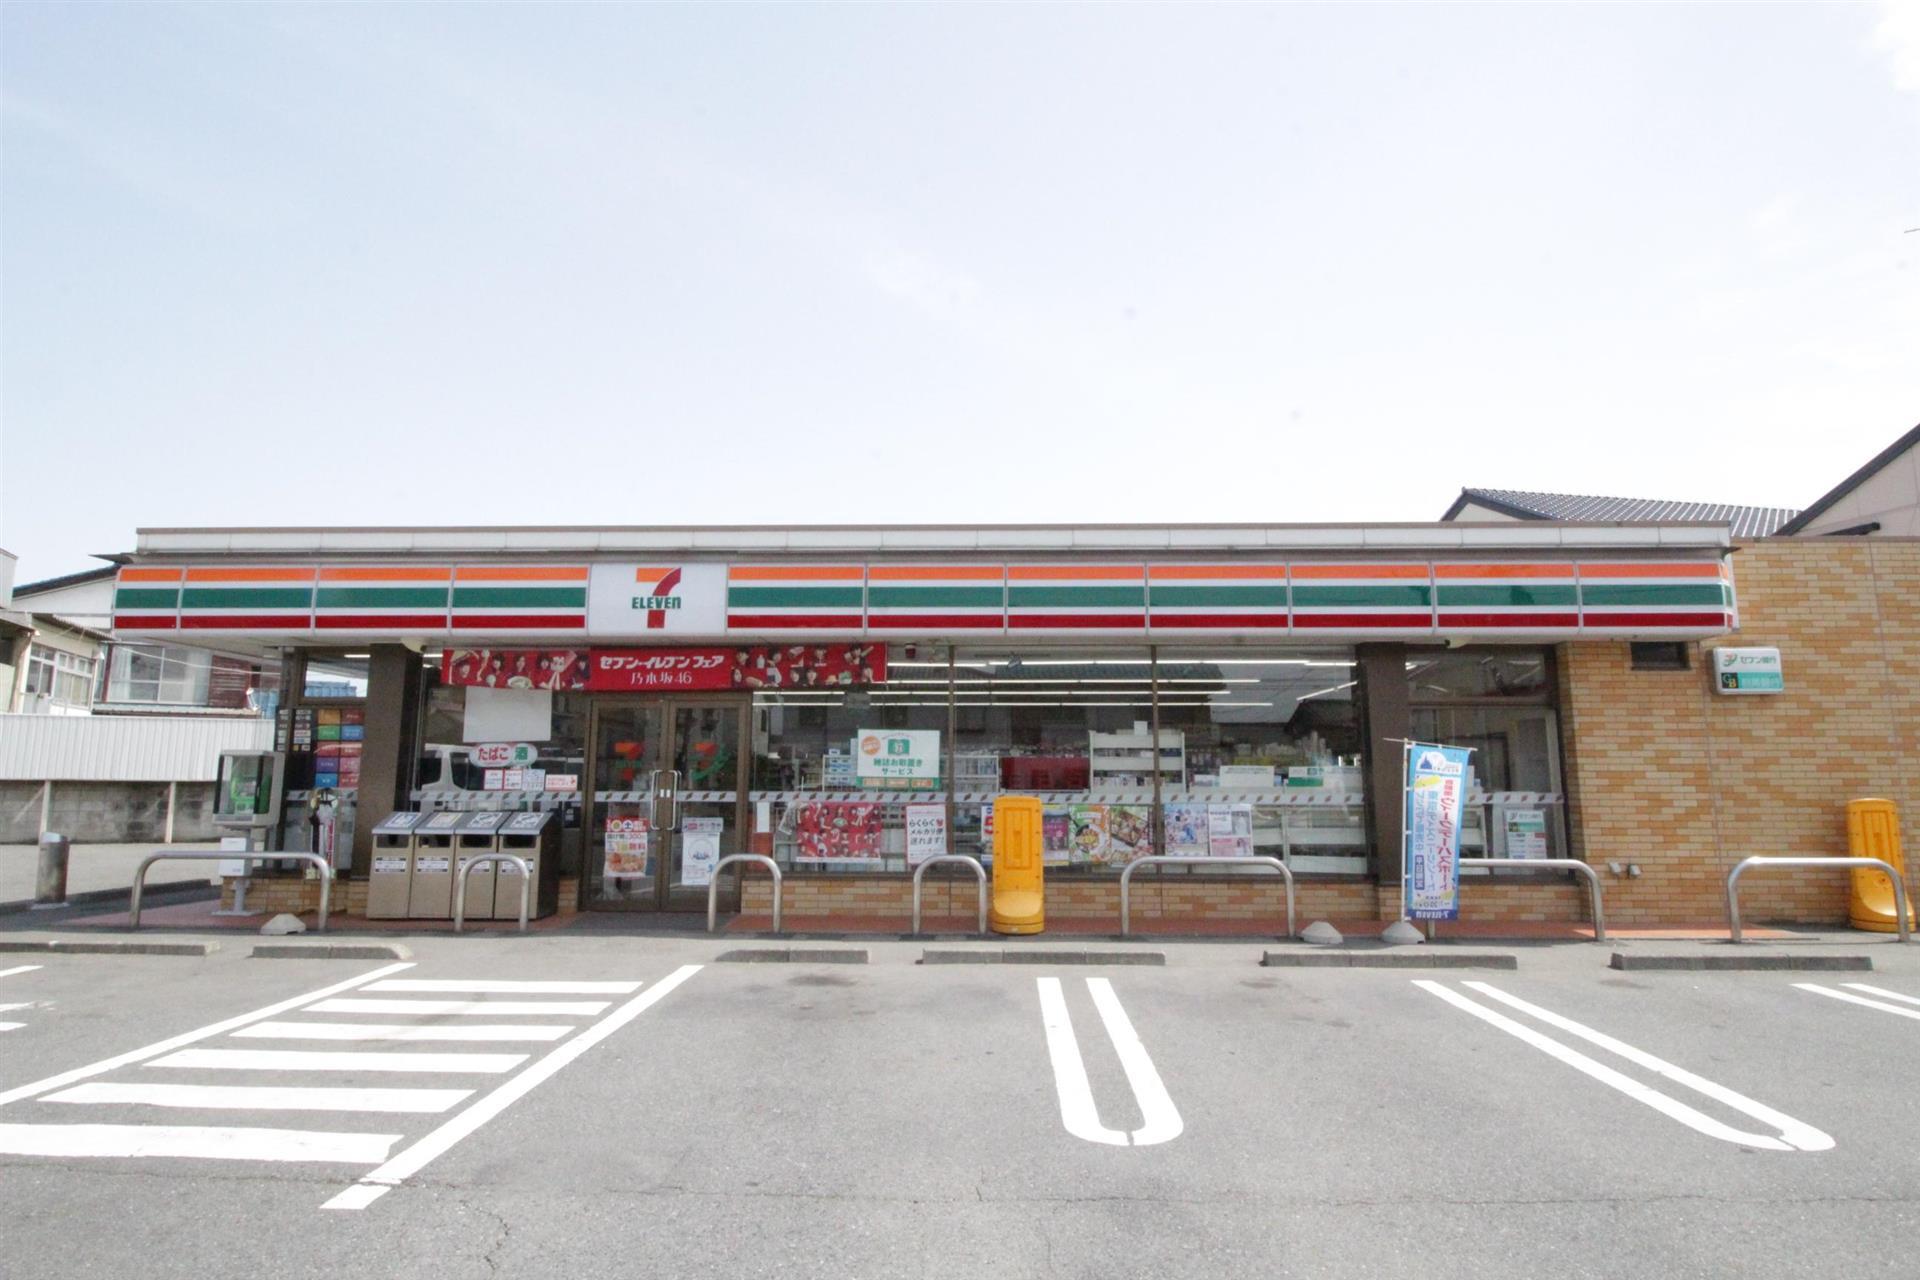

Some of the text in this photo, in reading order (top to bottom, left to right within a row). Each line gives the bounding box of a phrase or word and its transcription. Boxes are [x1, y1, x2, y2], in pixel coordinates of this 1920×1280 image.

[693, 656, 725, 668] フェア
[631, 671, 692, 685] 乃木坂46
[479, 747, 509, 760] たばこ
[909, 818, 935, 827] らくらく
